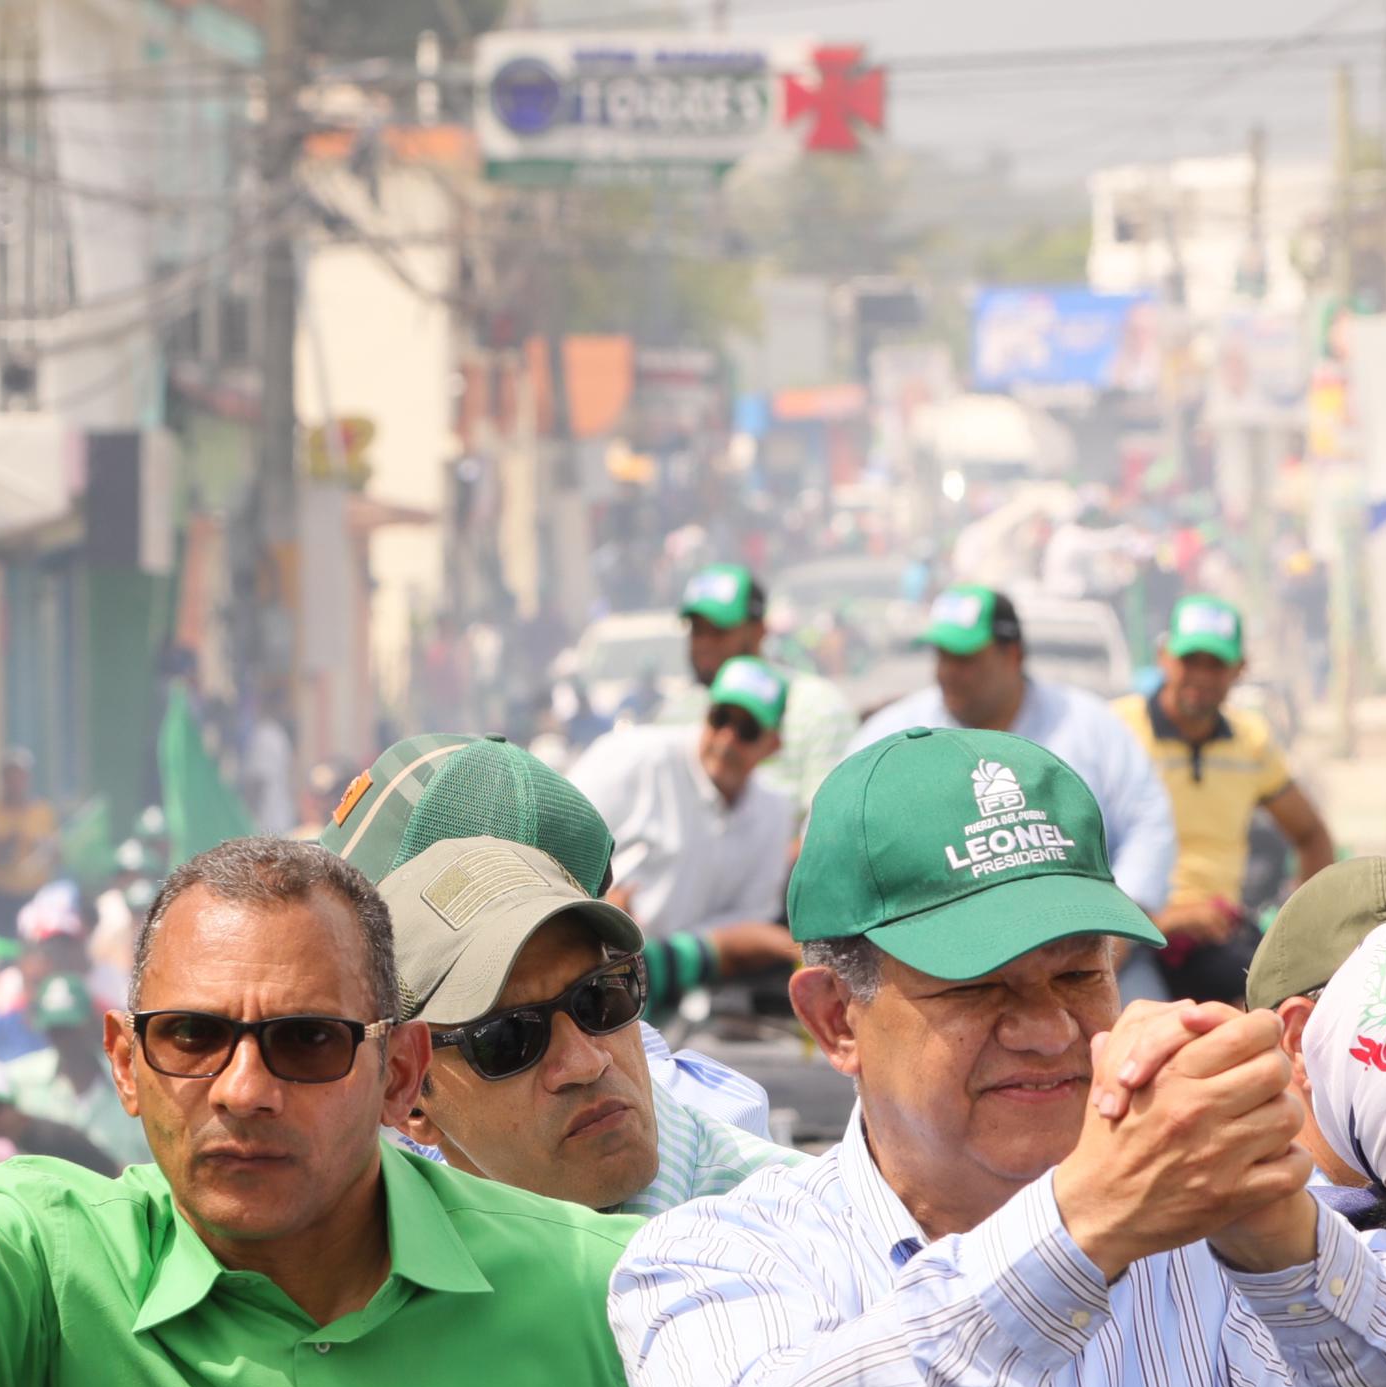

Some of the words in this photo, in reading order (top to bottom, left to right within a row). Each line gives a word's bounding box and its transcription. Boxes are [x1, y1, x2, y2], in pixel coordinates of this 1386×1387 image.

[964, 816, 1000, 836] FUERZA
[944, 823, 1075, 870] LEONEL
[971, 846, 1067, 879] PRESIDENTE
